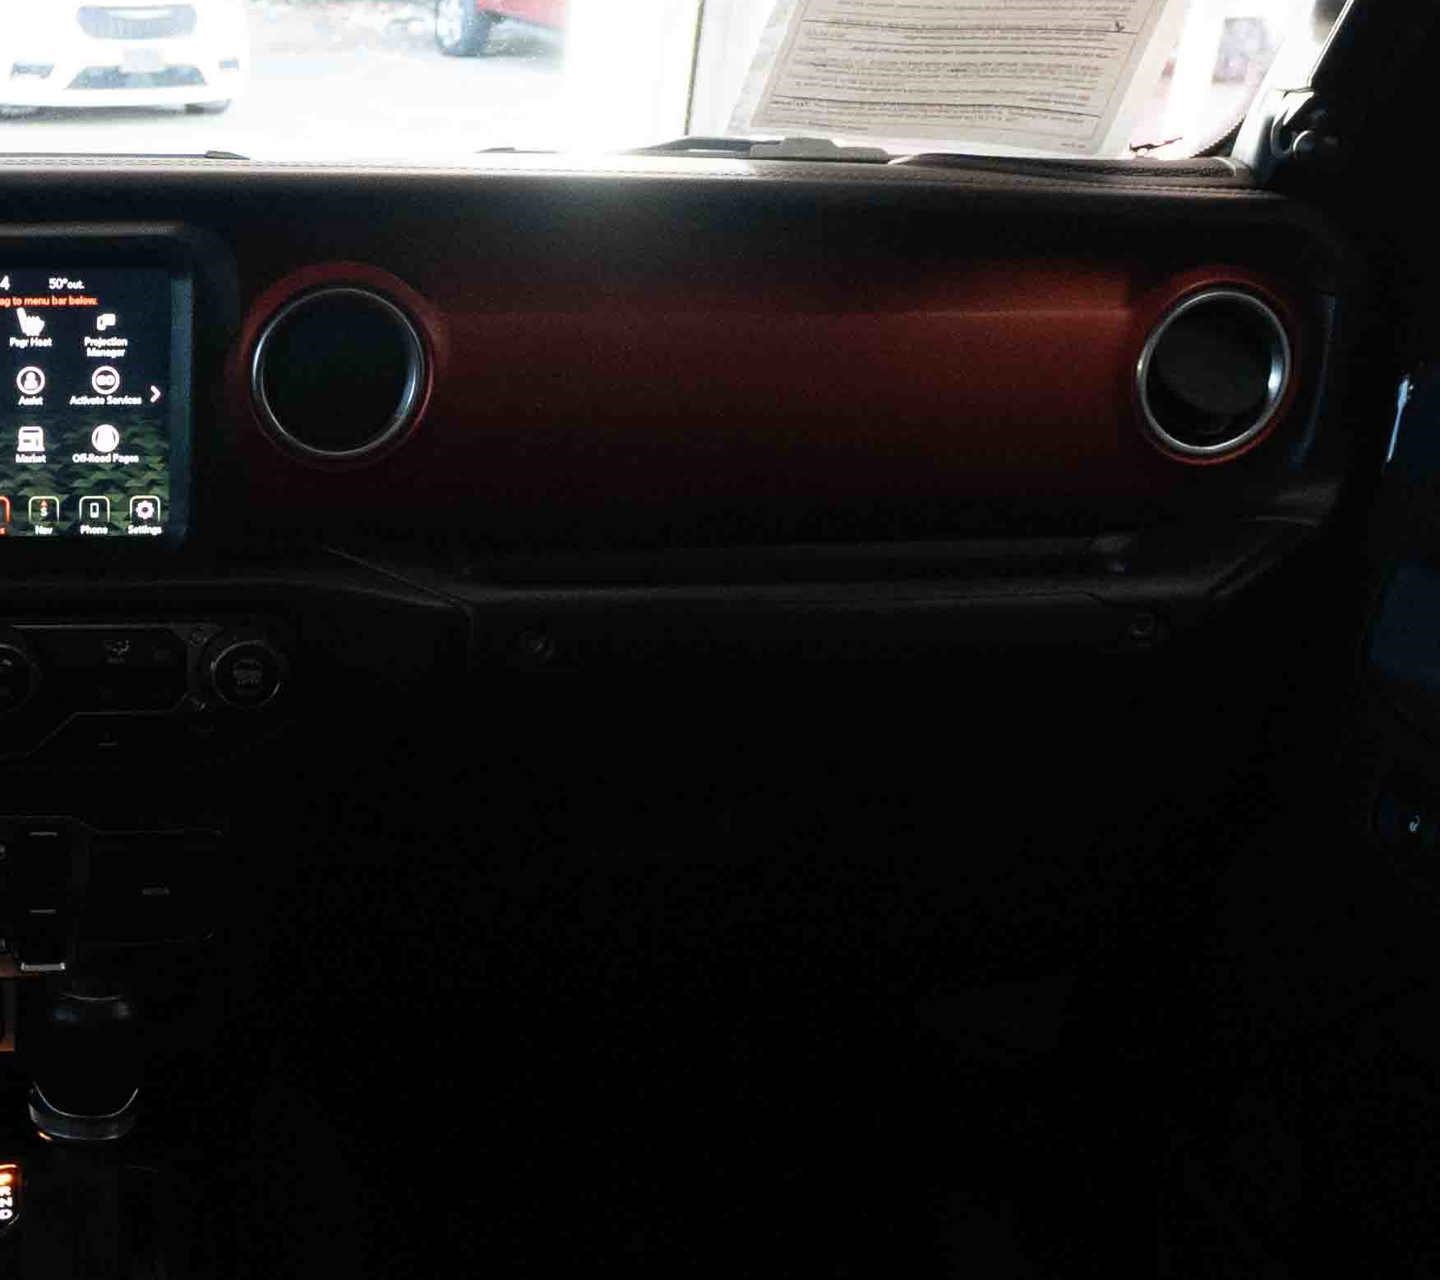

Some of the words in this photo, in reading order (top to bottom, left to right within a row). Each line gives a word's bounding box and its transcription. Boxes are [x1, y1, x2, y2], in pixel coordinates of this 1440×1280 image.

[12, 297, 22, 306] to
[24, 297, 50, 306] menu
[51, 296, 67, 306] bar
[30, 337, 53, 347] Heat
[84, 336, 128, 348] Projection
[18, 396, 44, 406] Assist
[70, 395, 106, 405] Activate
[106, 395, 142, 405] Services
[15, 453, 47, 464] Market
[72, 453, 111, 464] Off-Road
[113, 453, 139, 465] Pages
[39, 507, 49, 517] S
[35, 525, 53, 535] Nav
[80, 525, 108, 535] Phone
[127, 525, 163, 536] Settings
[0, 1197, 13, 1208] N
[0, 1209, 13, 1220] D
